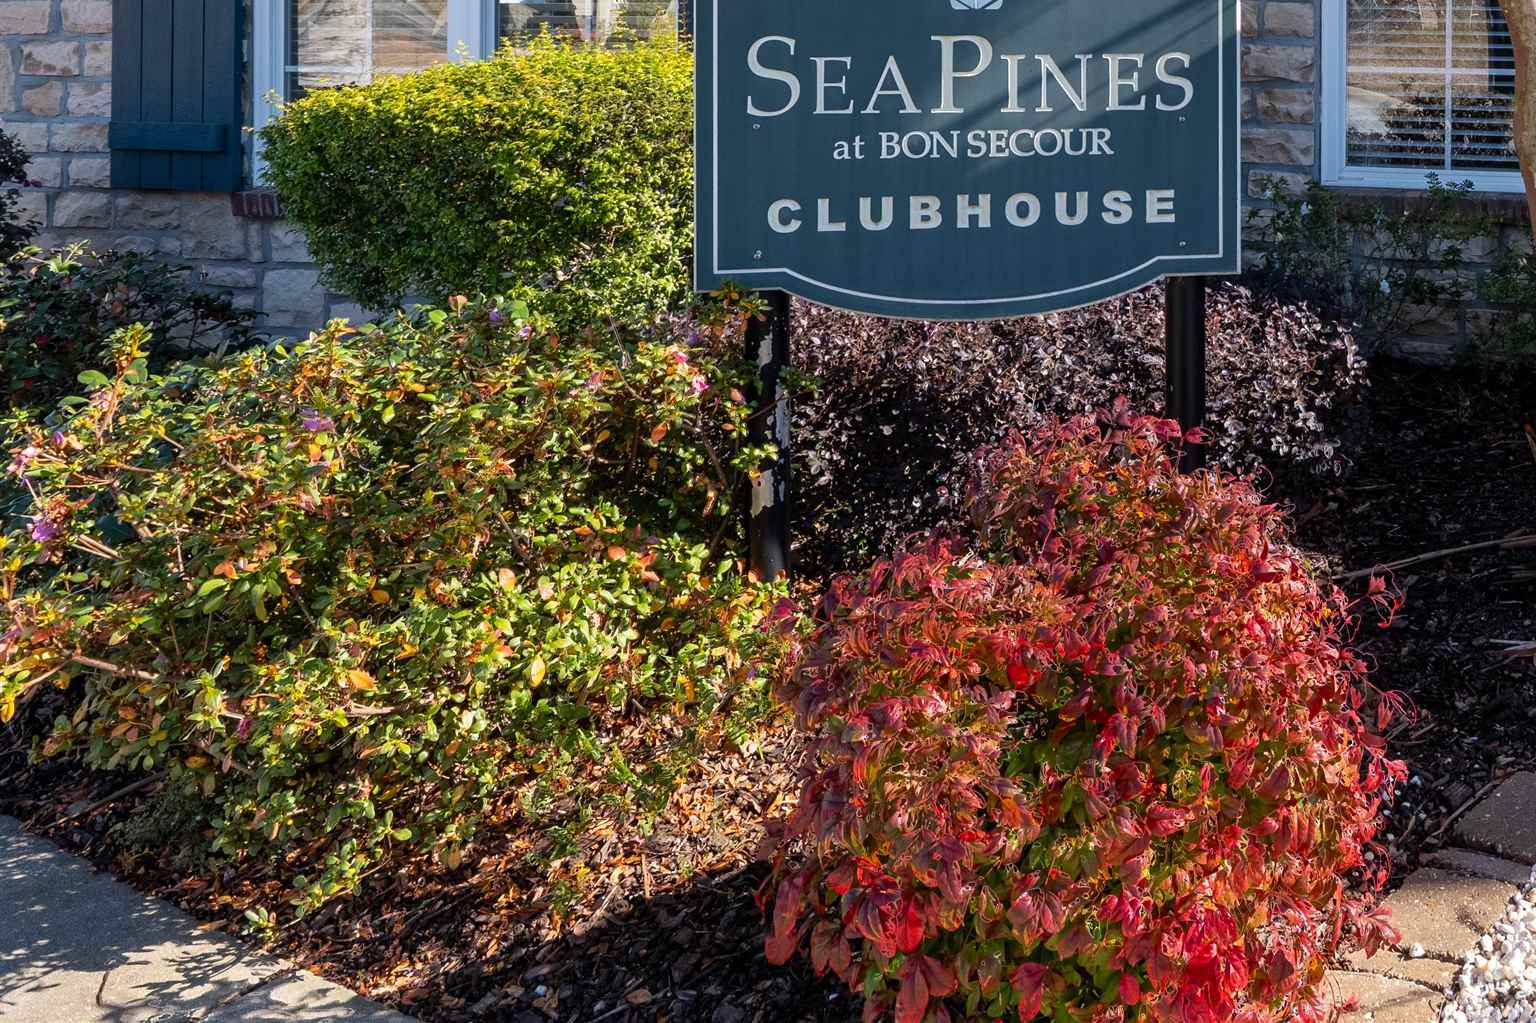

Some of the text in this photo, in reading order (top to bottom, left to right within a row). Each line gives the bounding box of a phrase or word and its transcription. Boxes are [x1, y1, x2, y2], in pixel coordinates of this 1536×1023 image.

[746, 34, 1194, 117] SEA PINES
[832, 127, 1114, 160] at BON SECOUR
[766, 188, 1177, 234] CLUBHOUSE
